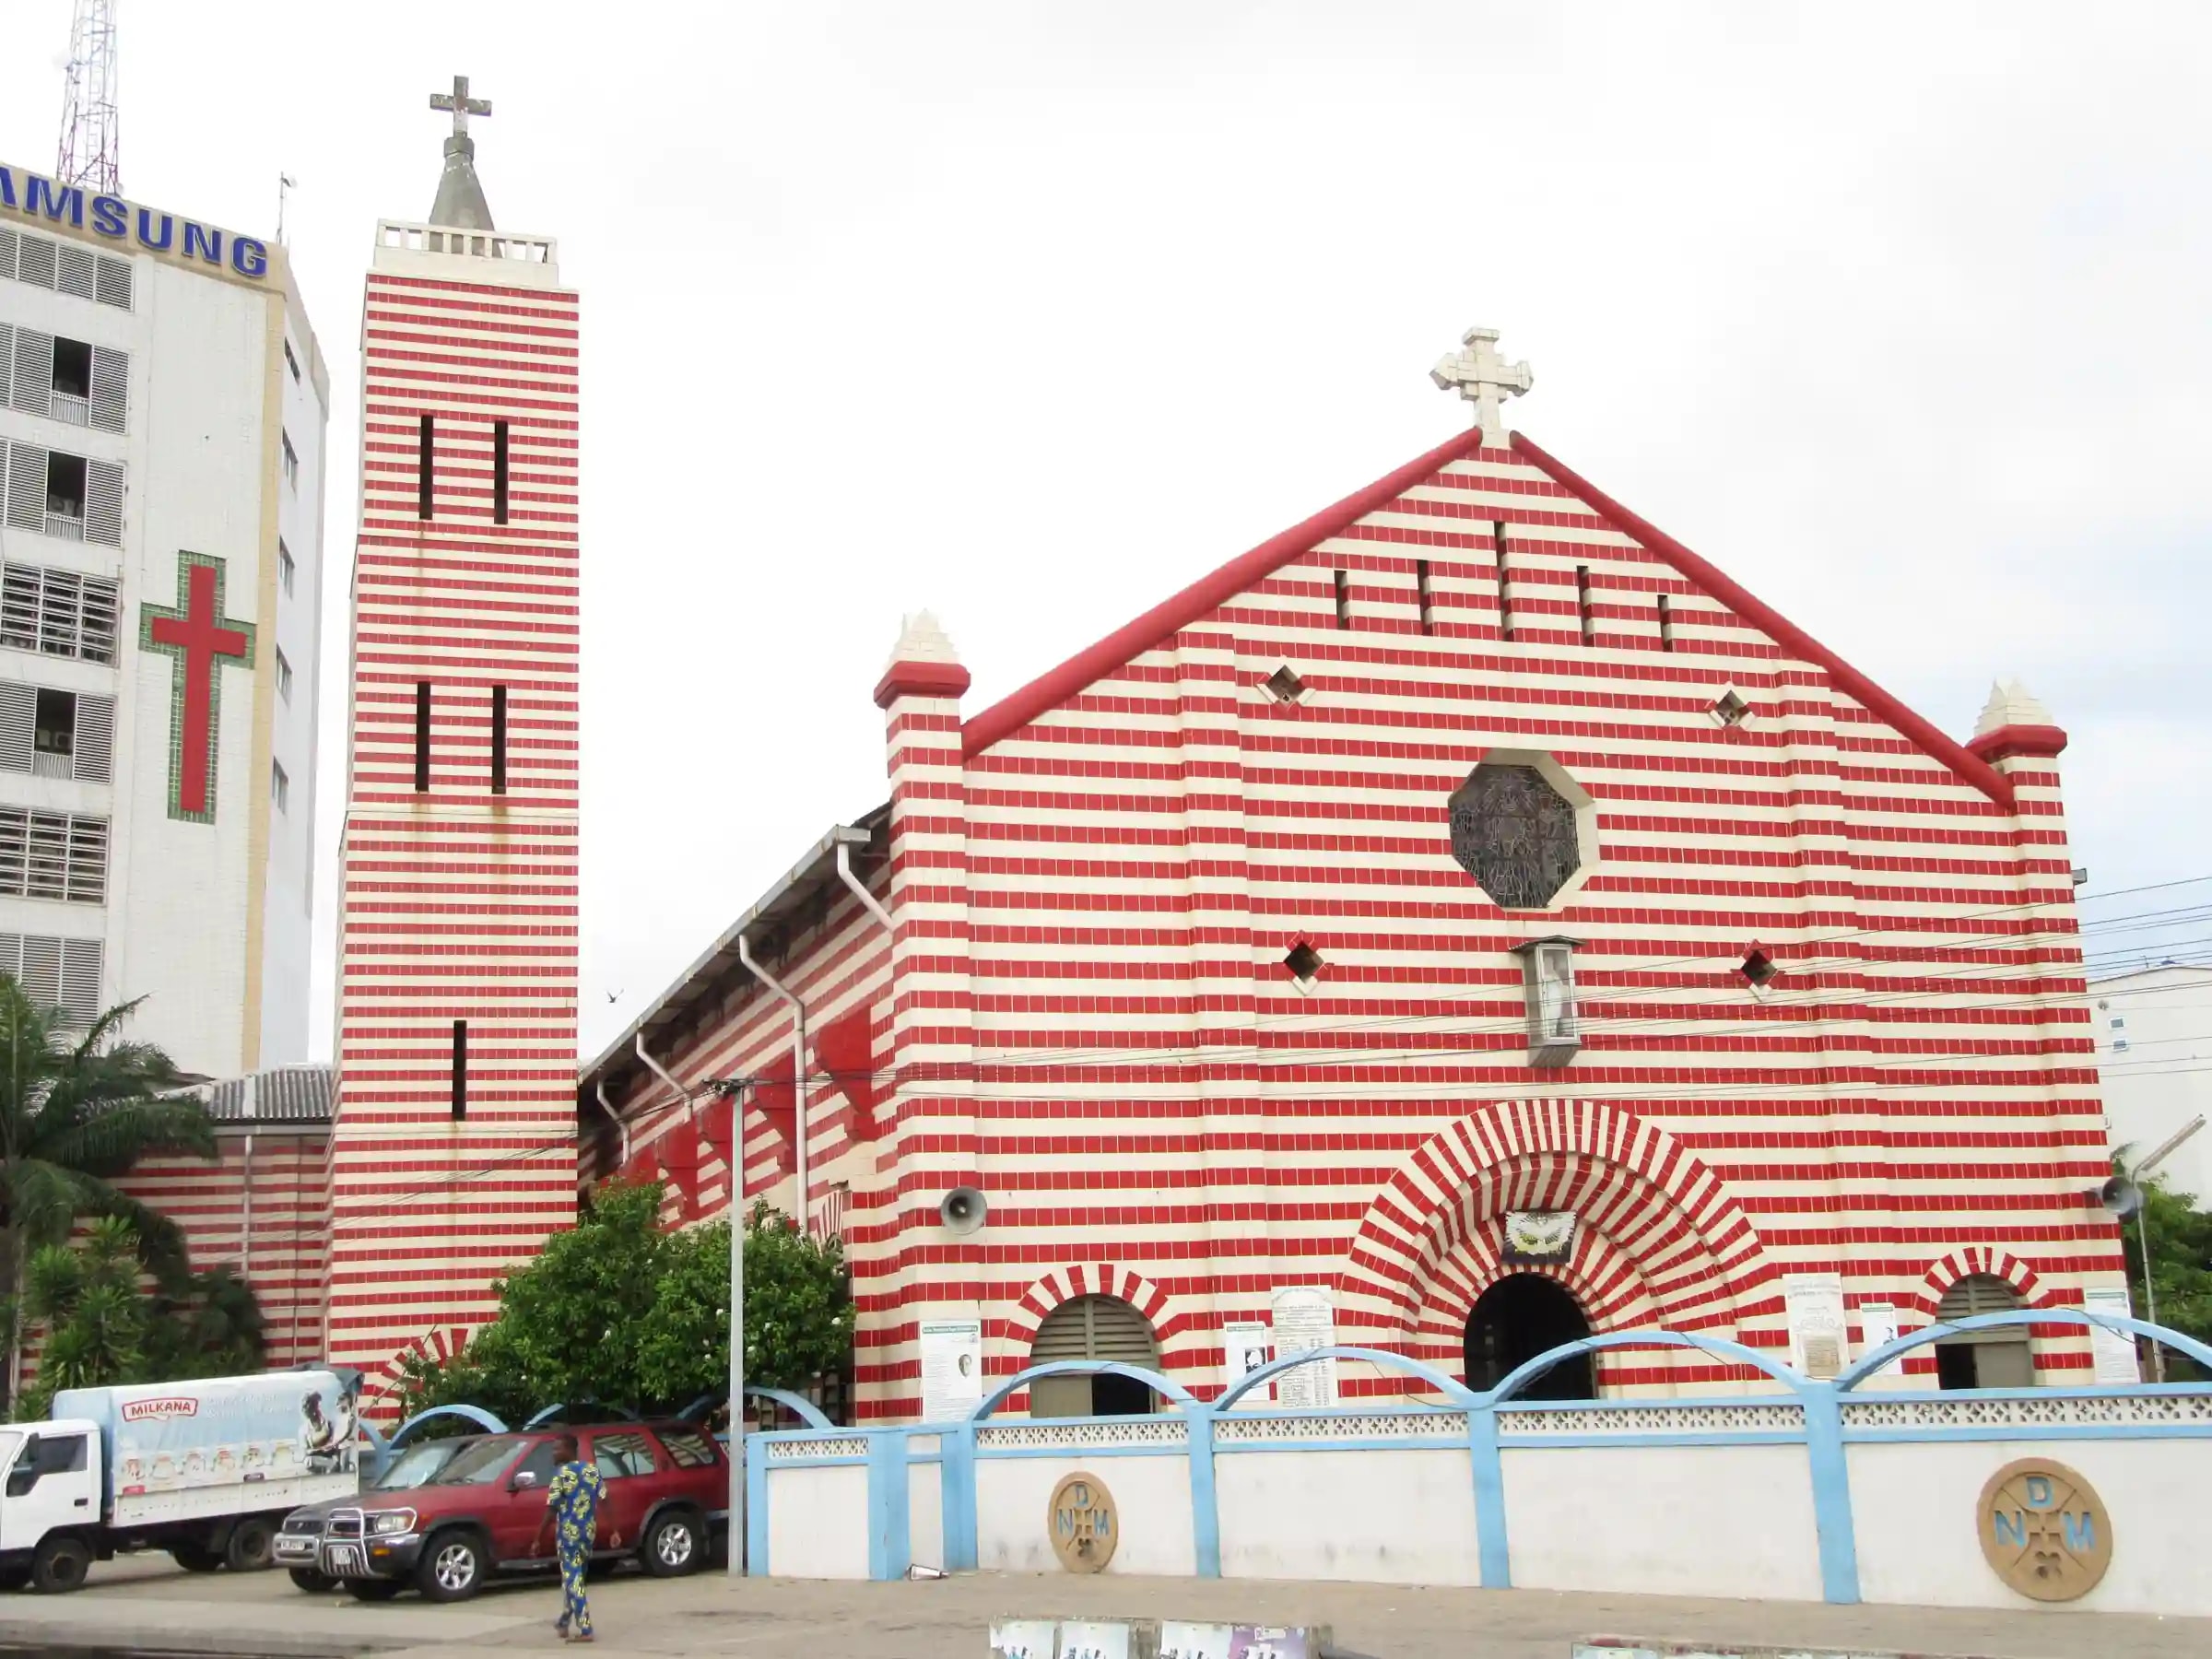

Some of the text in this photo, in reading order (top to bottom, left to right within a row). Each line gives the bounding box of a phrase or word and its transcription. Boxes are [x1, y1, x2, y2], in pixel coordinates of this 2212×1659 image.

[131, 1401, 191, 1416] MILKANA
[1076, 1484, 1088, 1507] D
[2025, 1477, 2053, 1507] D
[1058, 1509, 1109, 1536] N M
[1994, 1510, 2095, 1552] N M
